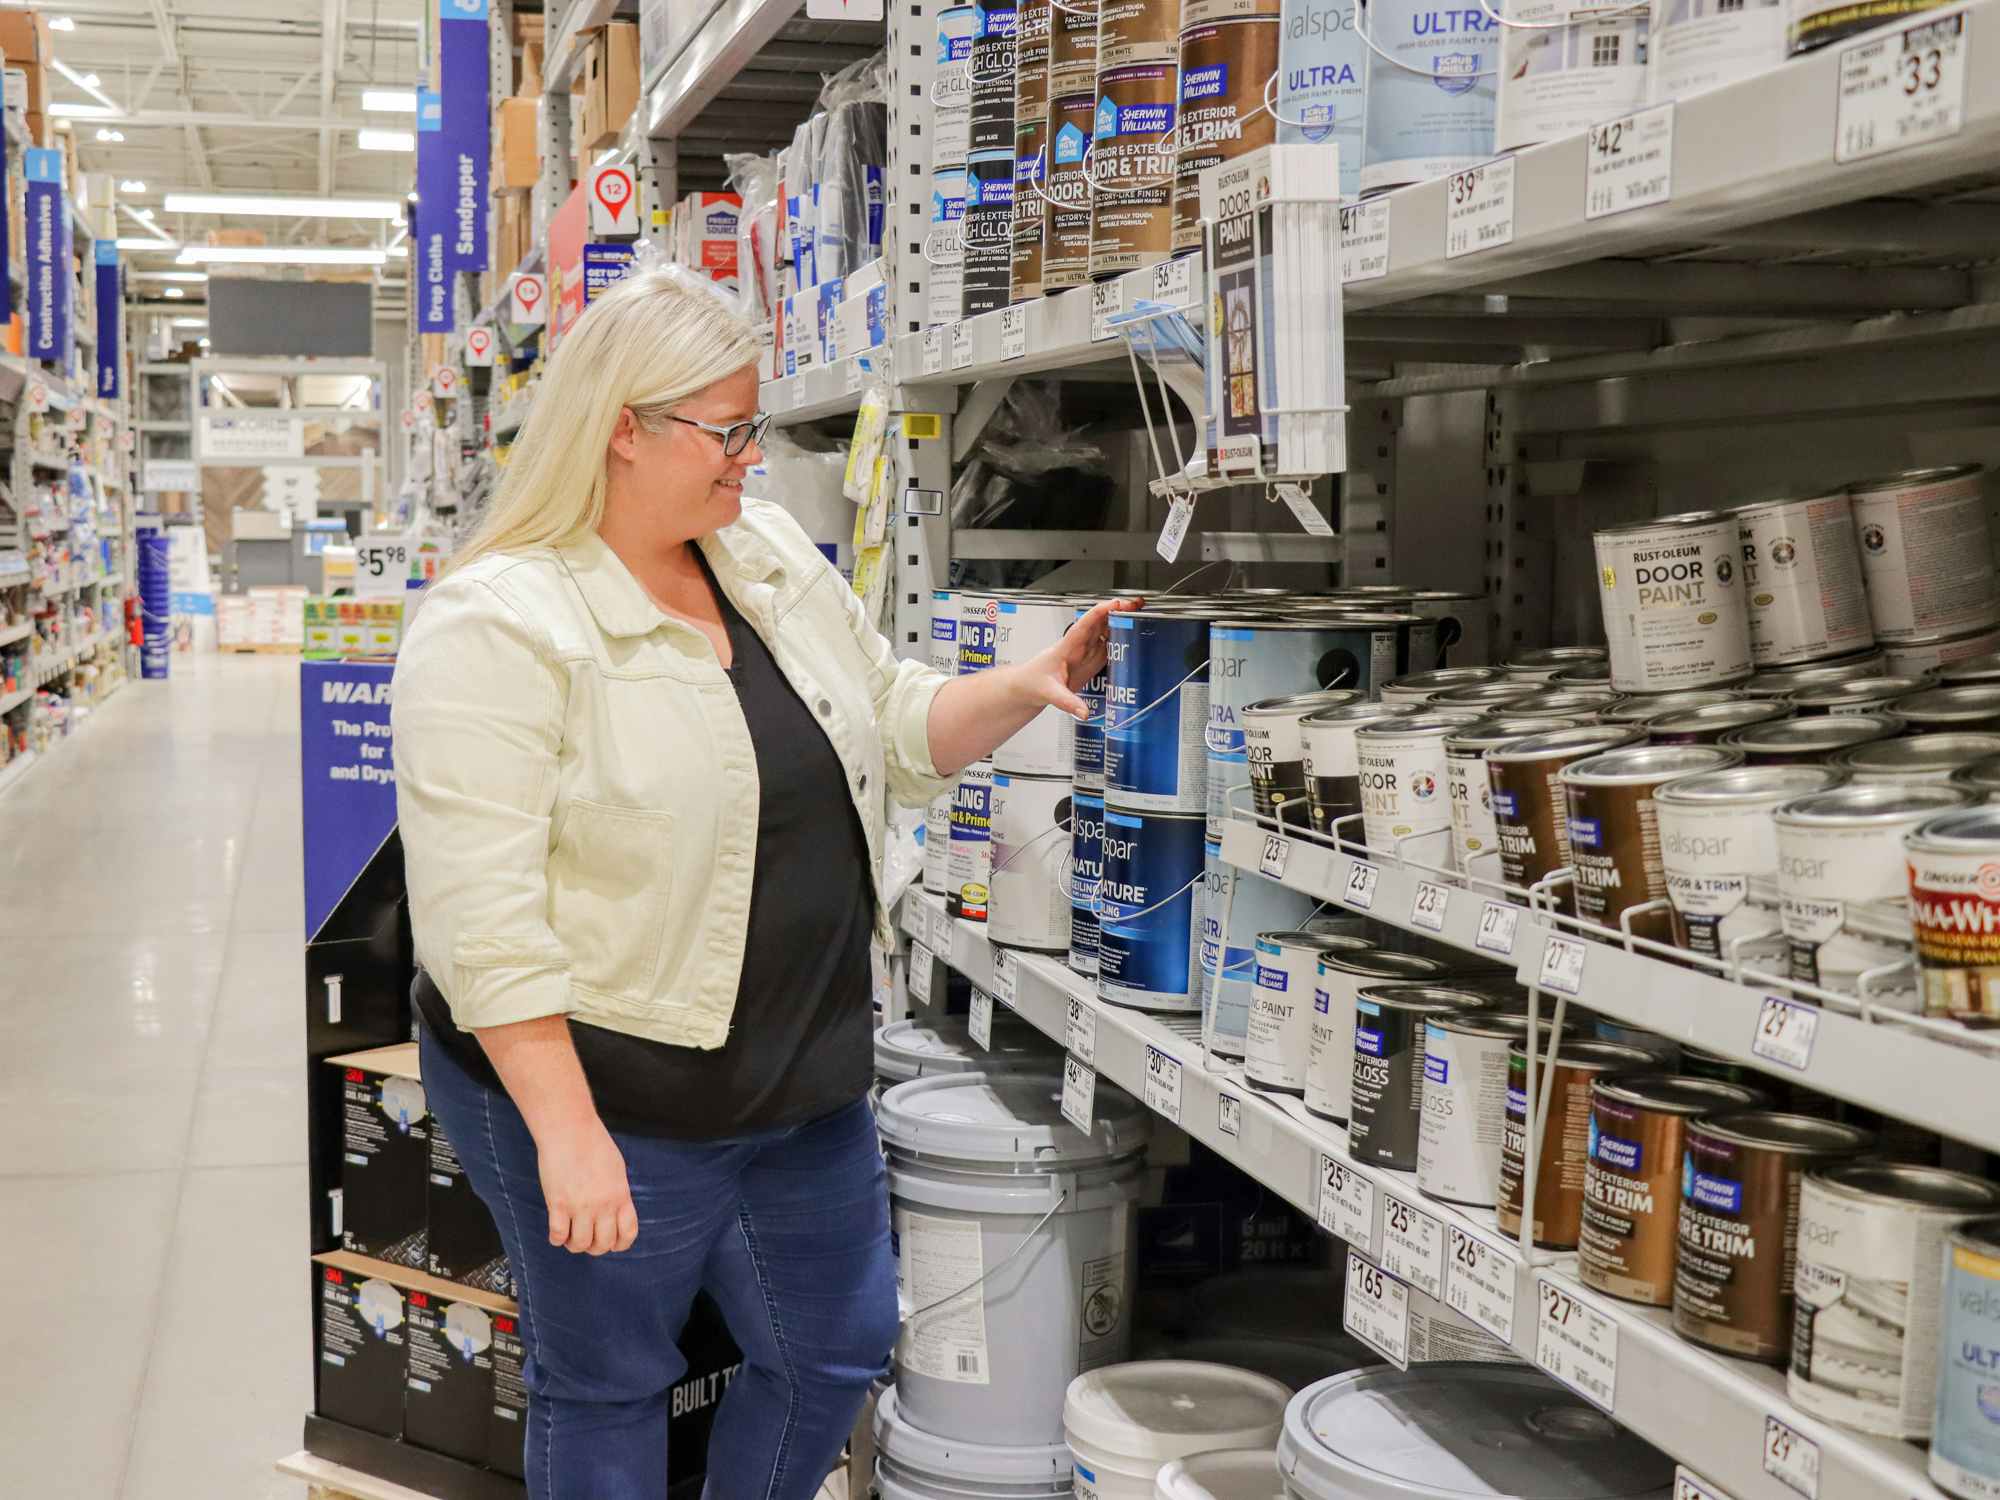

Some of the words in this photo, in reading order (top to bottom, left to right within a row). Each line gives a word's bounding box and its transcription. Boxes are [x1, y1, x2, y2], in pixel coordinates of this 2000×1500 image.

[1185, 69, 1221, 85] SHERWIN
[1289, 64, 1355, 91] ULTRA
[1184, 82, 1220, 98] WILLIAMS
[1122, 108, 1167, 121] SHERWIN
[1187, 106, 1237, 122] EXTERIOR
[1121, 119, 1166, 132] WILLIAMS
[1192, 119, 1242, 142] TRIM
[1119, 159, 1132, 172] &
[606, 184, 621, 195] 12
[1136, 189, 1167, 200] FINISH
[456, 153, 477, 254] Sandpaper
[1219, 190, 1250, 218] DOOR
[37, 194, 52, 262] Adhesives
[1220, 215, 1252, 246] PAINT
[429, 234, 443, 282] Cloths
[38, 264, 52, 350] Construction
[429, 283, 446, 321] Drop
[1633, 545, 1702, 563] RUST-OLEUM
[1636, 561, 1704, 585] DOOR
[1639, 581, 1705, 605] PAINT
[332, 720, 361, 736] The
[361, 743, 384, 759] for
[330, 765, 360, 780] and
[1580, 867, 1621, 889] TRIM
[1705, 879, 1743, 892] TRIM
[1803, 903, 1839, 917] TRIM
[1261, 1001, 1295, 1018] PAINT
[1357, 1055, 1390, 1069] EXTERIOR
[345, 1068, 364, 1083] 3M
[1600, 1134, 1637, 1157] SHERWIN
[1600, 1170, 1650, 1193] EXTERIOR
[1604, 1175, 1654, 1215] TRIM
[1697, 1213, 1751, 1237] EXTERIOR
[1702, 1226, 1756, 1260] TRIM
[325, 1267, 343, 1286] 3M
[410, 1290, 428, 1309] 3M
[495, 1314, 513, 1334] 3M
[672, 1371, 720, 1418] BUILT
